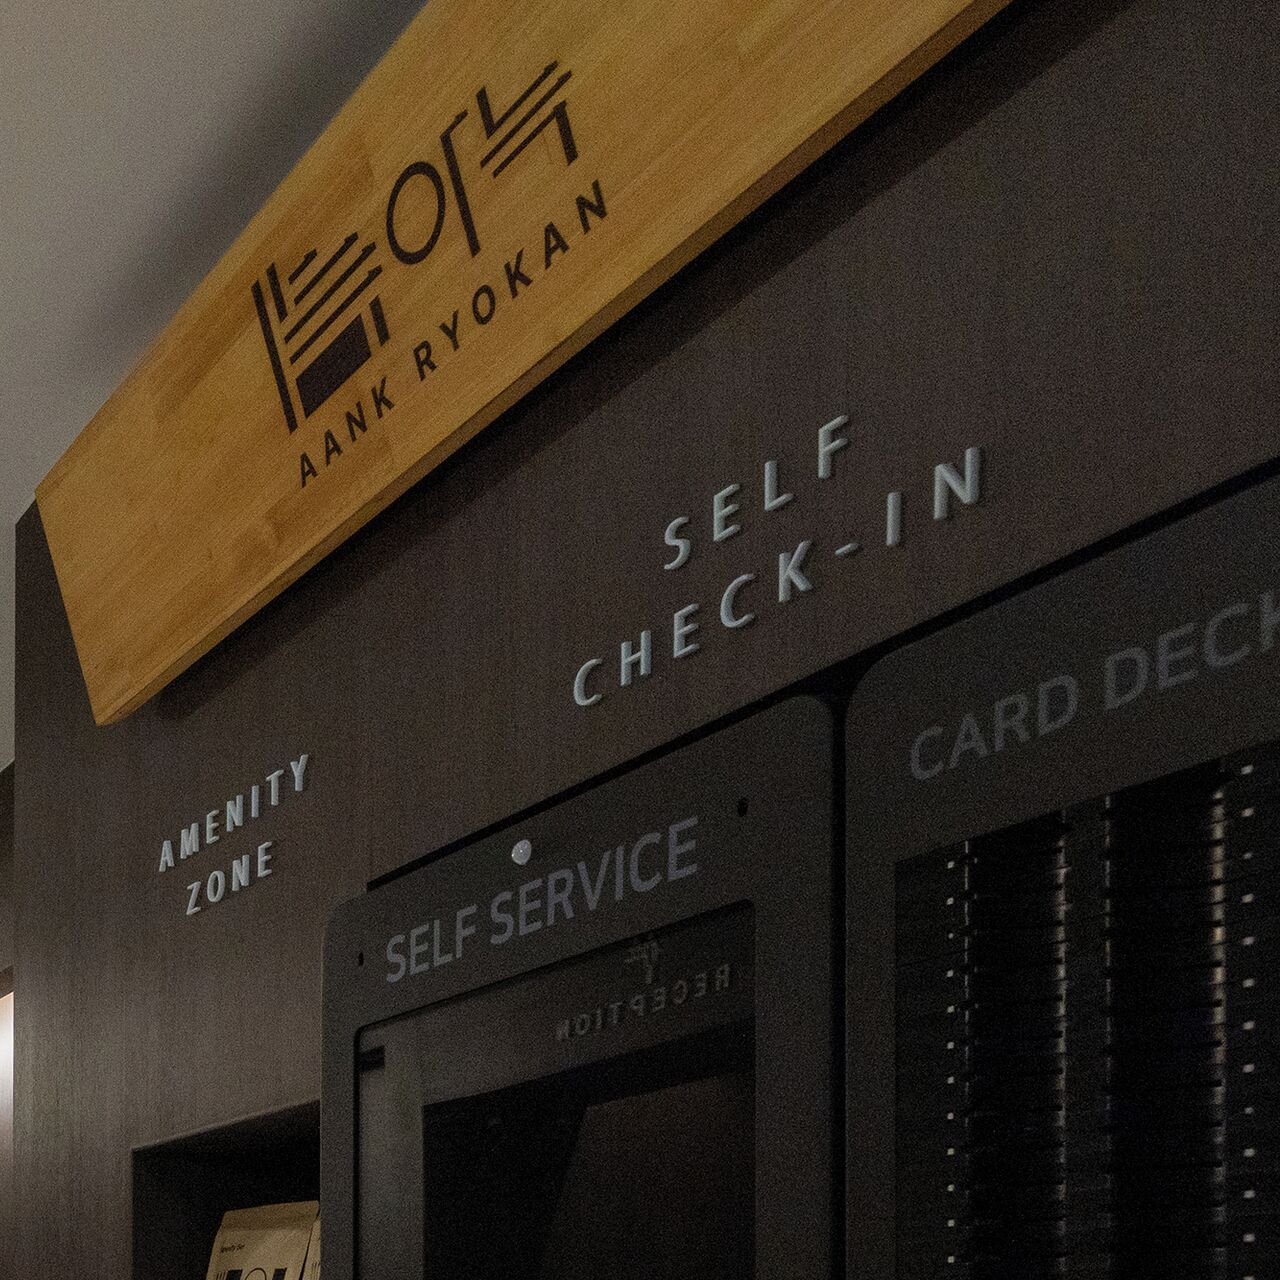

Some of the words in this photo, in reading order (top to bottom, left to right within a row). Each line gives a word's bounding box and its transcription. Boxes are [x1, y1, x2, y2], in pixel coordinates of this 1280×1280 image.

[299, 377, 397, 488] AANK
[414, 180, 608, 382] RYOKAN
[664, 414, 849, 571] SELF
[573, 447, 981, 706] CHECK-IN
[909, 674, 1079, 781] CARD
[158, 754, 309, 873] AMENITY
[186, 841, 273, 915] ZONE
[385, 903, 478, 983] SELF
[489, 816, 700, 945] SERVICE
